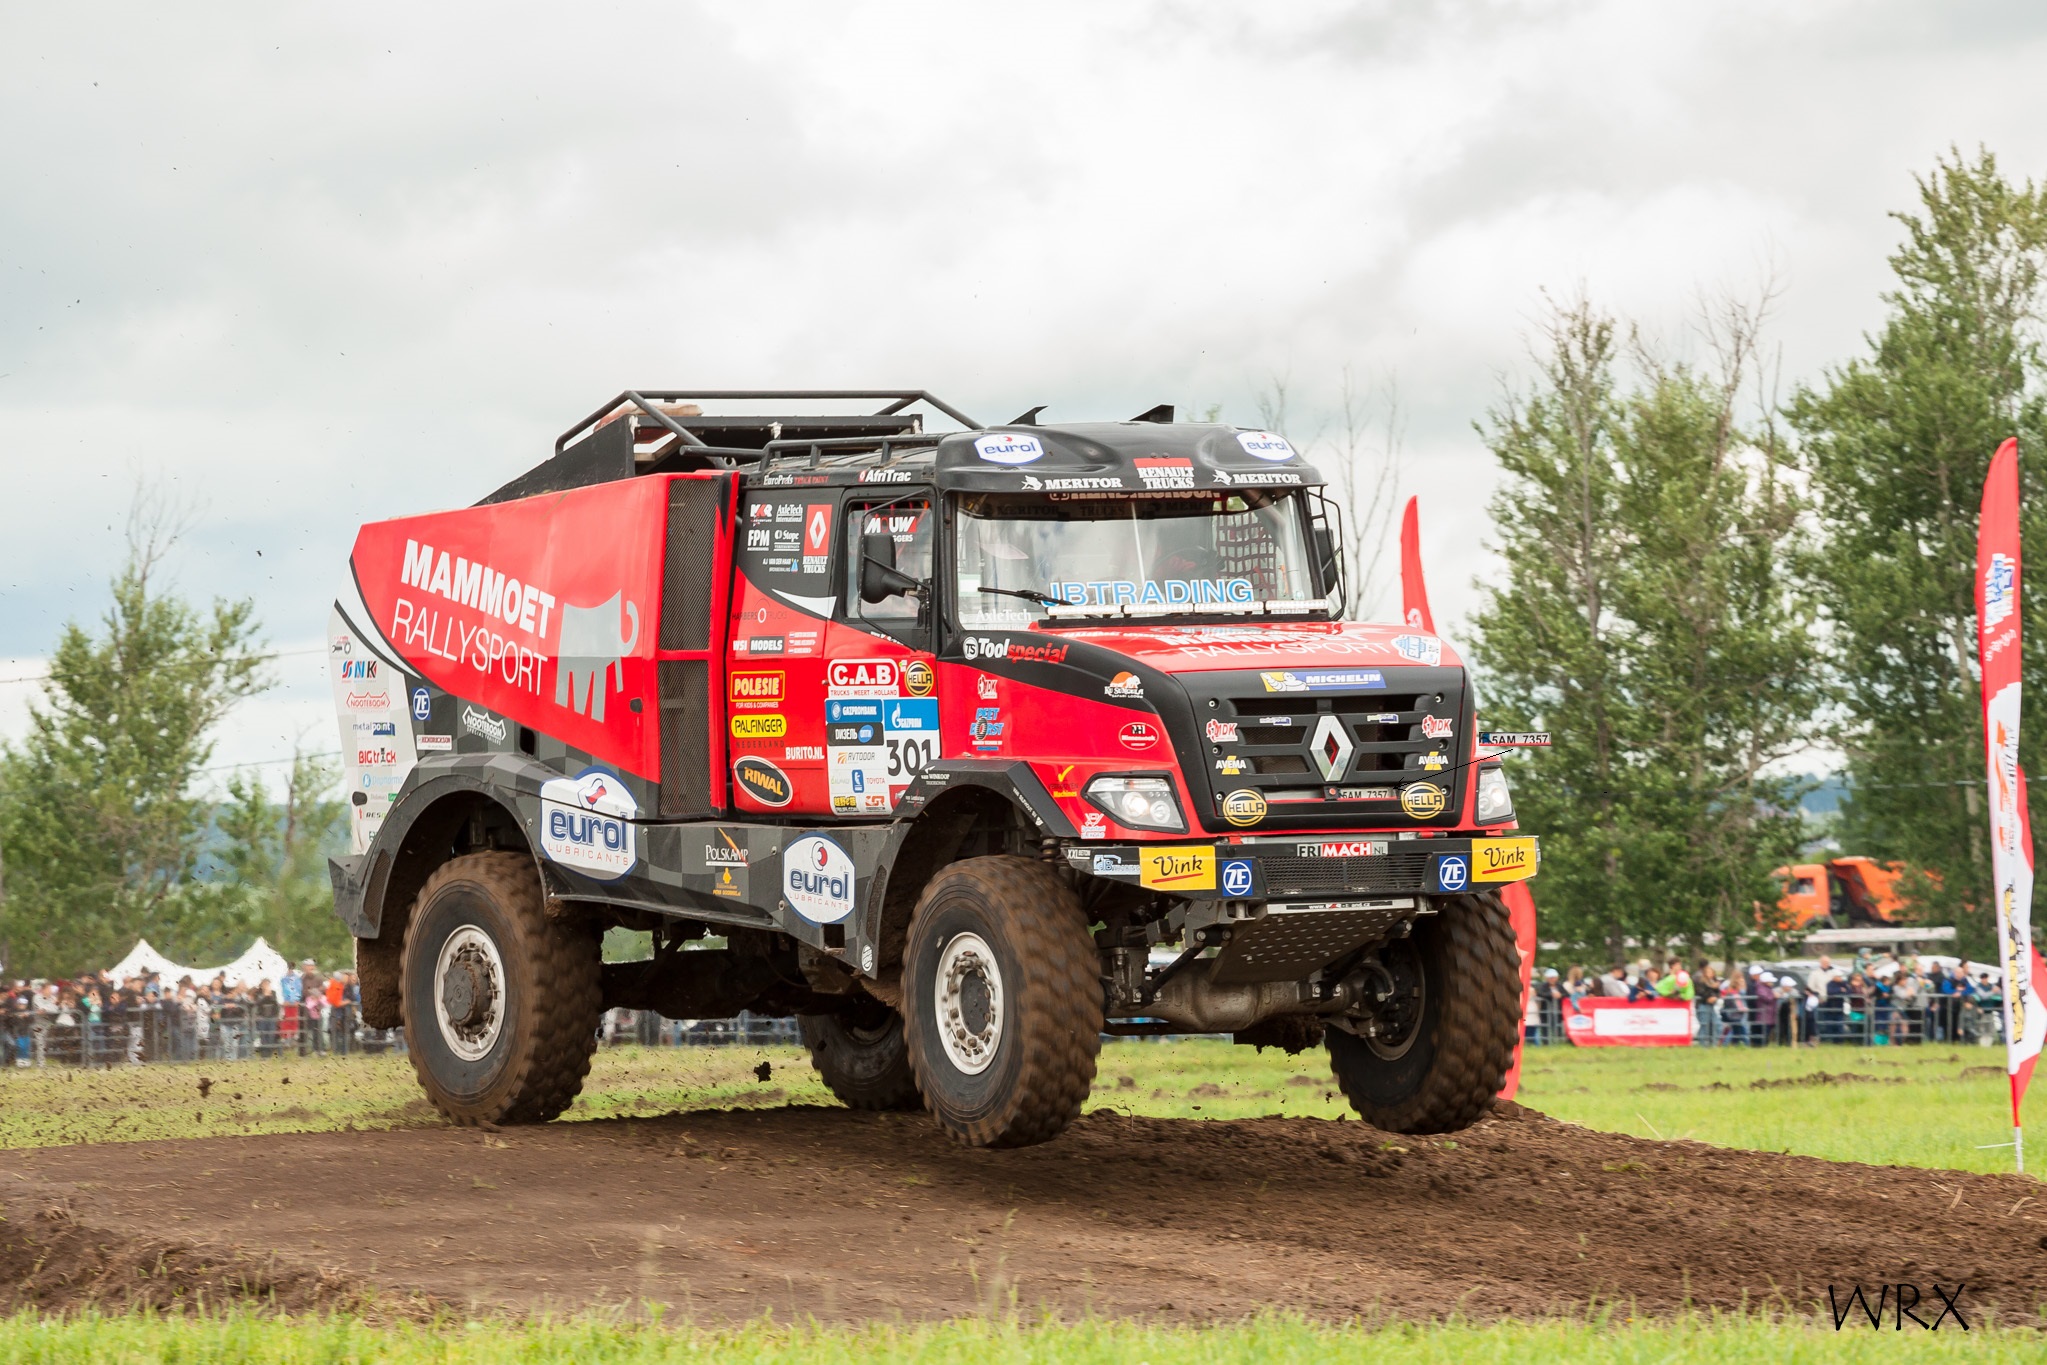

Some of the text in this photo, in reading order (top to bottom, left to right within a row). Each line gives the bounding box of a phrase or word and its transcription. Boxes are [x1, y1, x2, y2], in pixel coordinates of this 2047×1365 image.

[984, 442, 1036, 455] eurol
[1247, 440, 1290, 451] eurol
[865, 469, 912, 482] AfriTrac
[1137, 467, 1195, 478] RENAULT
[1232, 474, 1302, 484] MERITOR
[1044, 478, 1124, 490] MERITOR
[1143, 478, 1195, 489] TRUCKS
[777, 504, 803, 515] AxleTech
[864, 516, 917, 534] MOUW
[747, 530, 770, 546] FPM
[802, 556, 828, 565] RENAULT
[803, 565, 826, 574] TRUCKS
[401, 539, 556, 639] MAMMOET
[732, 612, 758, 620] HARBERS
[976, 608, 1031, 621] AxleTech
[391, 598, 549, 696] RALLYSPORT
[733, 640, 747, 651] WSI
[750, 640, 783, 651] MODELS
[966, 643, 976, 654] TS
[1179, 642, 1391, 658] RALLYSPORT
[342, 660, 377, 679] SNK
[833, 665, 892, 685] C.A.B
[908, 673, 932, 684] HELLA
[1306, 673, 1381, 684] MICHELIN
[734, 677, 780, 696] POLESIE
[414, 694, 429, 714] ZF
[466, 714, 503, 737] NOOTEBOOM
[735, 719, 783, 733] PALFINGER
[736, 740, 785, 749] NEDERLAND
[785, 746, 825, 760] BURITO.NL
[886, 738, 932, 777] 301
[1216, 760, 1247, 769] AVEMA
[1418, 755, 1449, 765] AVEMA
[744, 766, 784, 797] RIWAL
[1367, 790, 1388, 798] 7357
[1407, 795, 1443, 806] HELLA
[1228, 802, 1265, 813] HELLA
[550, 809, 628, 853] eurol
[548, 843, 629, 866] LUBRICANTS
[1067, 849, 1079, 859] XXL
[1484, 846, 1525, 867] Vink
[1153, 855, 1204, 876] Vink
[1226, 869, 1250, 889] ZF
[1442, 863, 1465, 884] ZF
[790, 868, 849, 901] eurol
[789, 893, 849, 910] LUBRICANTS
